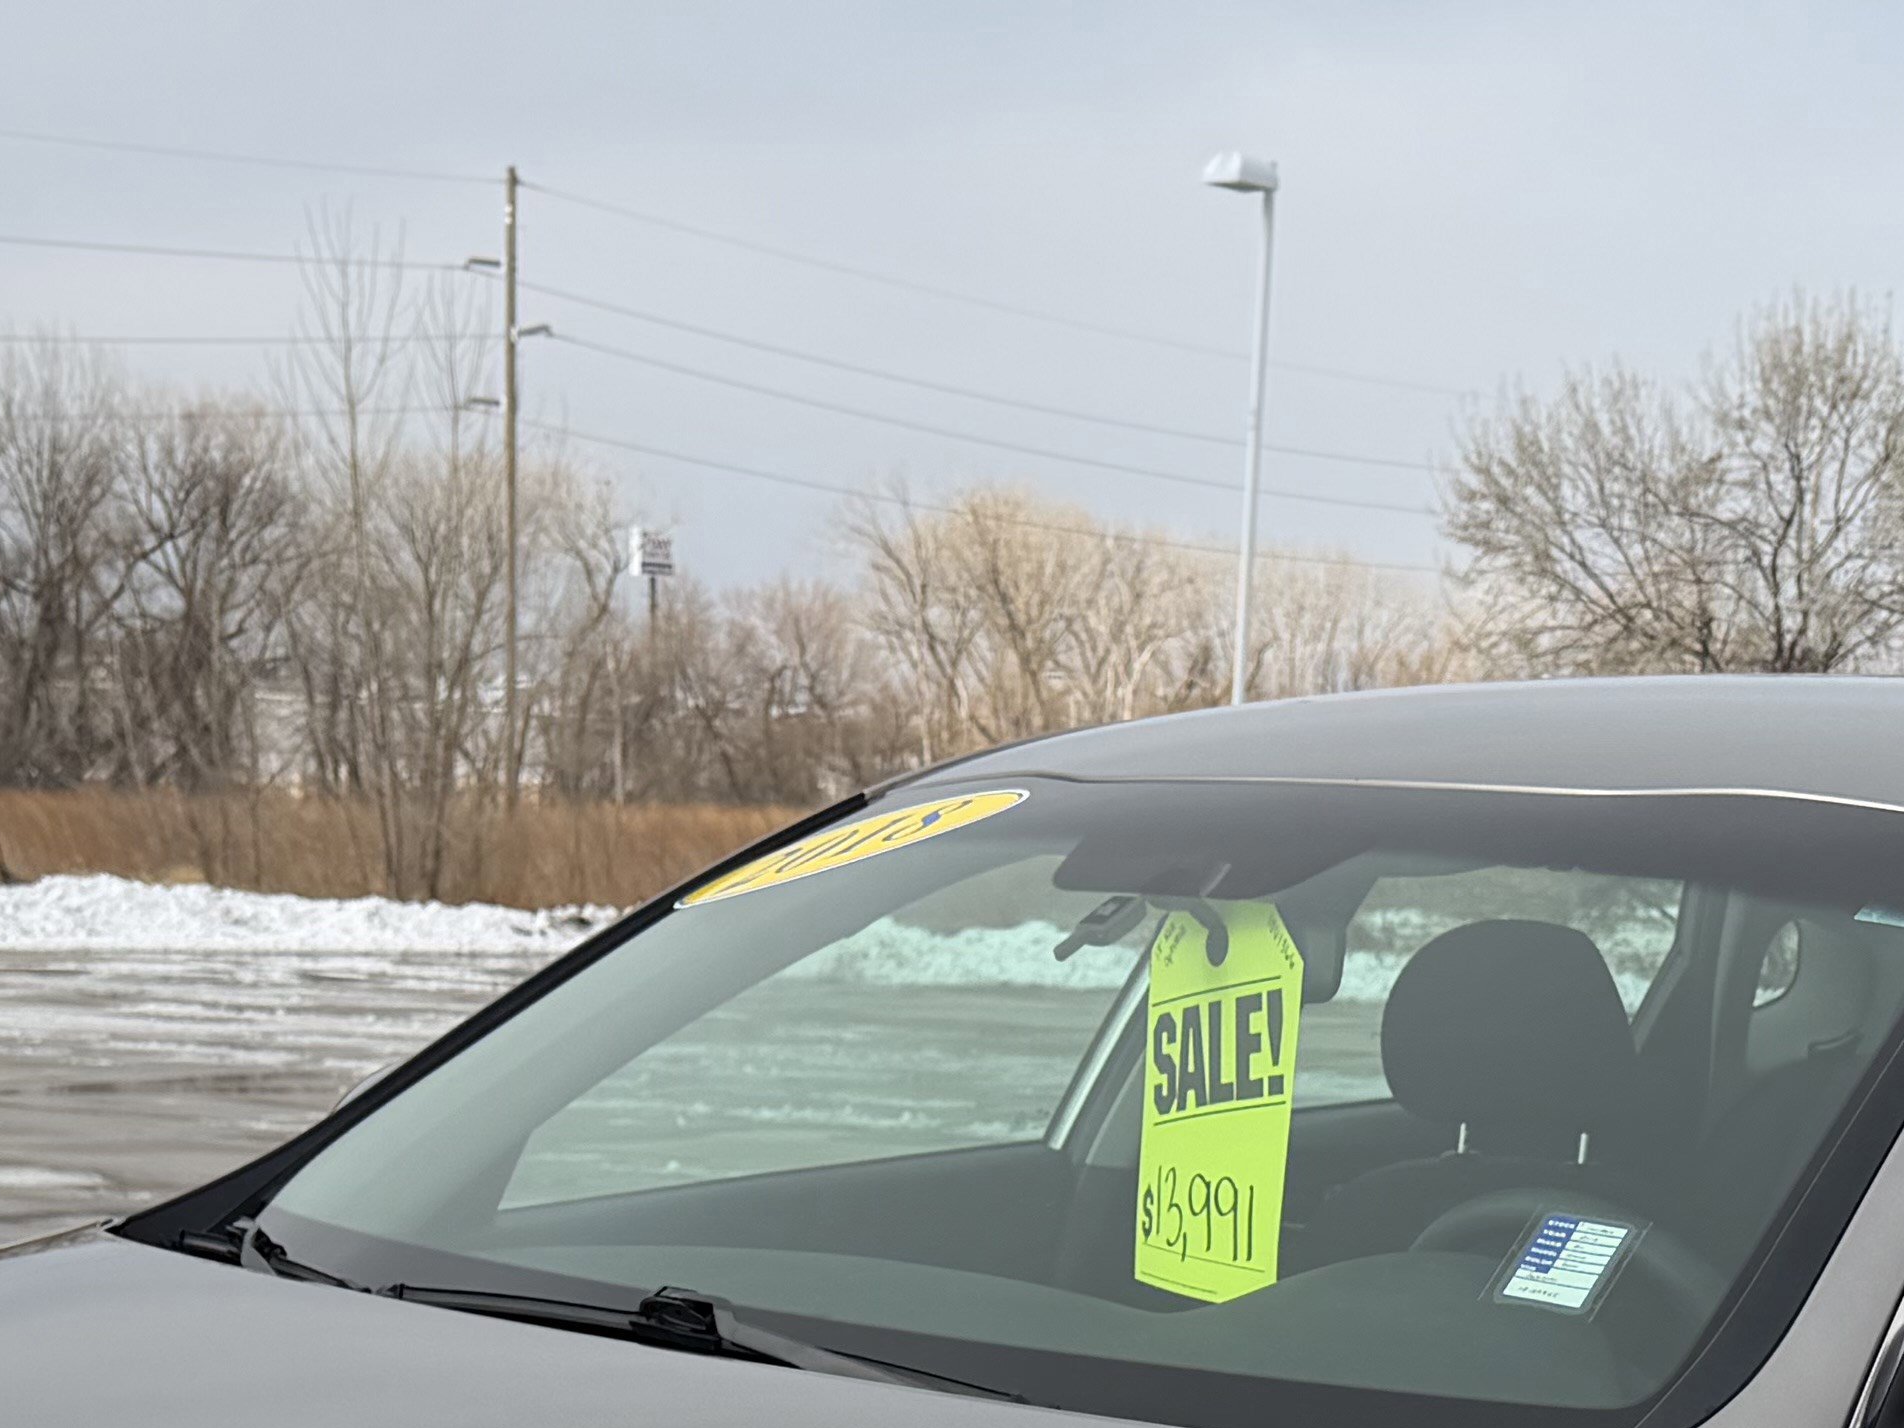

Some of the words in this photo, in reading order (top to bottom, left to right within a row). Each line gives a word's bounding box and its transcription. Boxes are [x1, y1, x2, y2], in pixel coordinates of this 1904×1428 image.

[704, 798, 975, 899] 2018
[1152, 987, 1285, 1116] SALE!
[1141, 1164, 1255, 1263] $13,991
